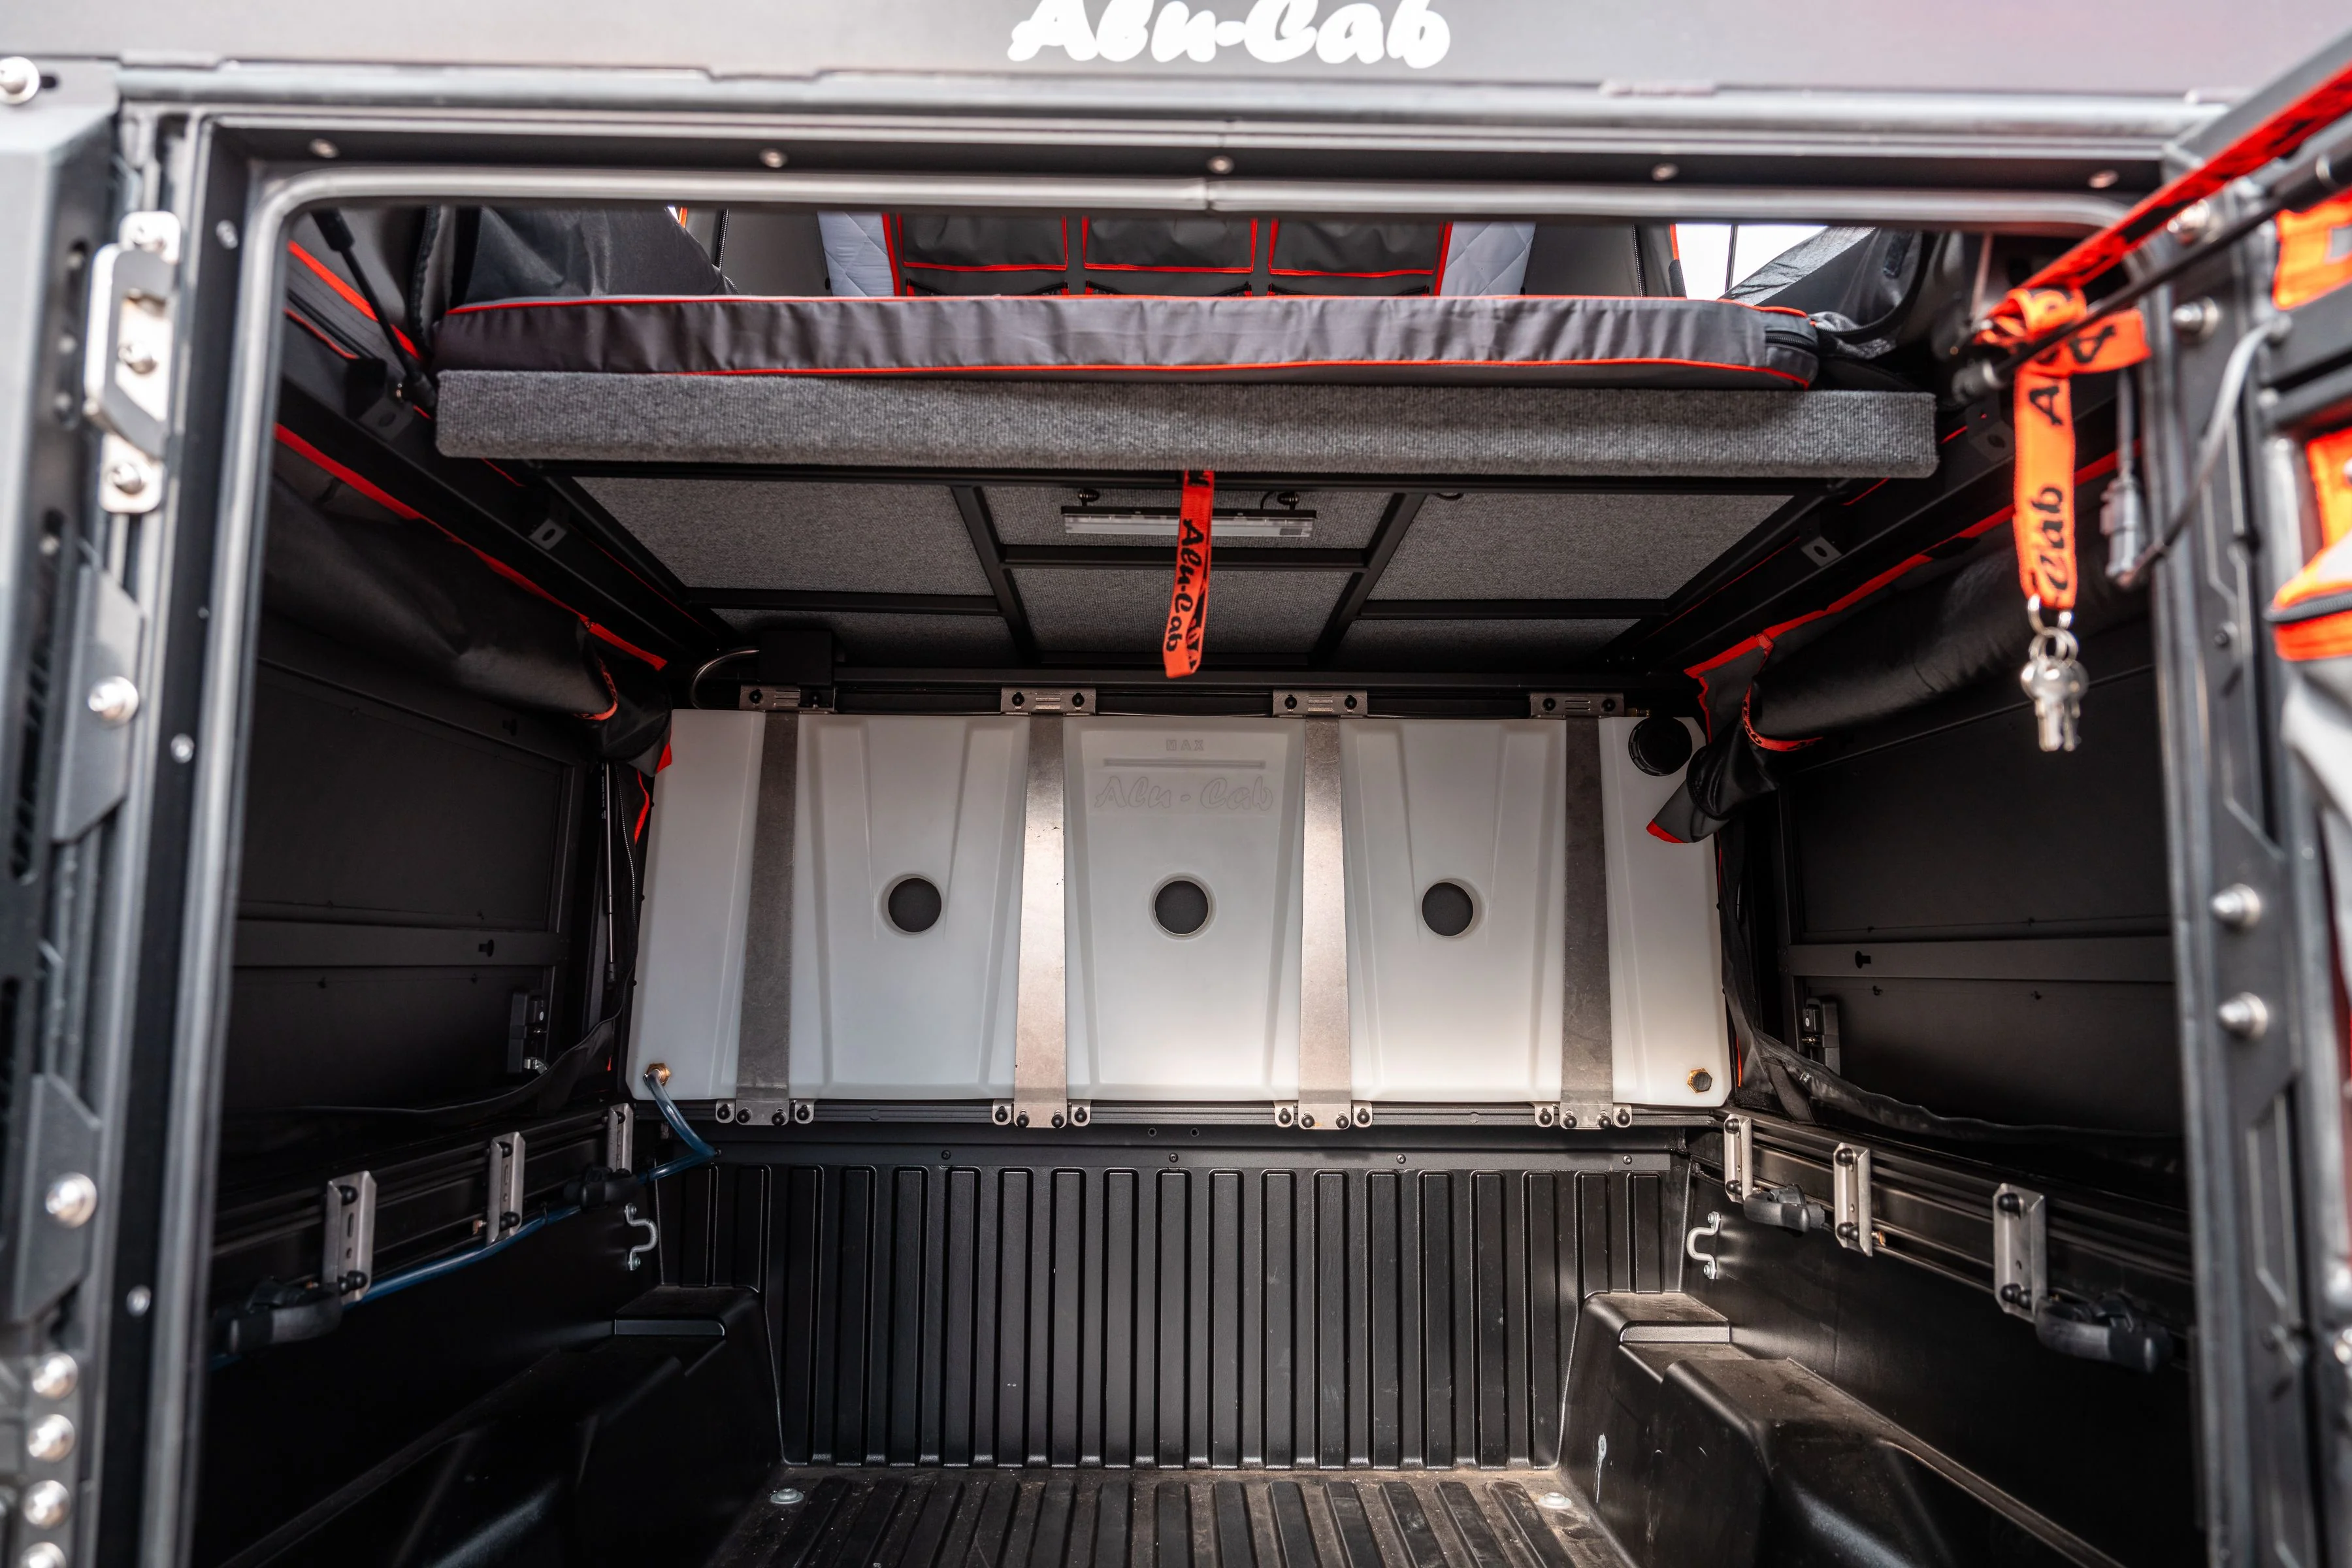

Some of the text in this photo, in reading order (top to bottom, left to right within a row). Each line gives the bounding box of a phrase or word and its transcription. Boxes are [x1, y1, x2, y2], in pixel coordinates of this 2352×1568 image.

[1007, 0, 1451, 69] Alu-Cab
[1165, 517, 1205, 653] Alu-Cab
[1166, 738, 1205, 752] MAX
